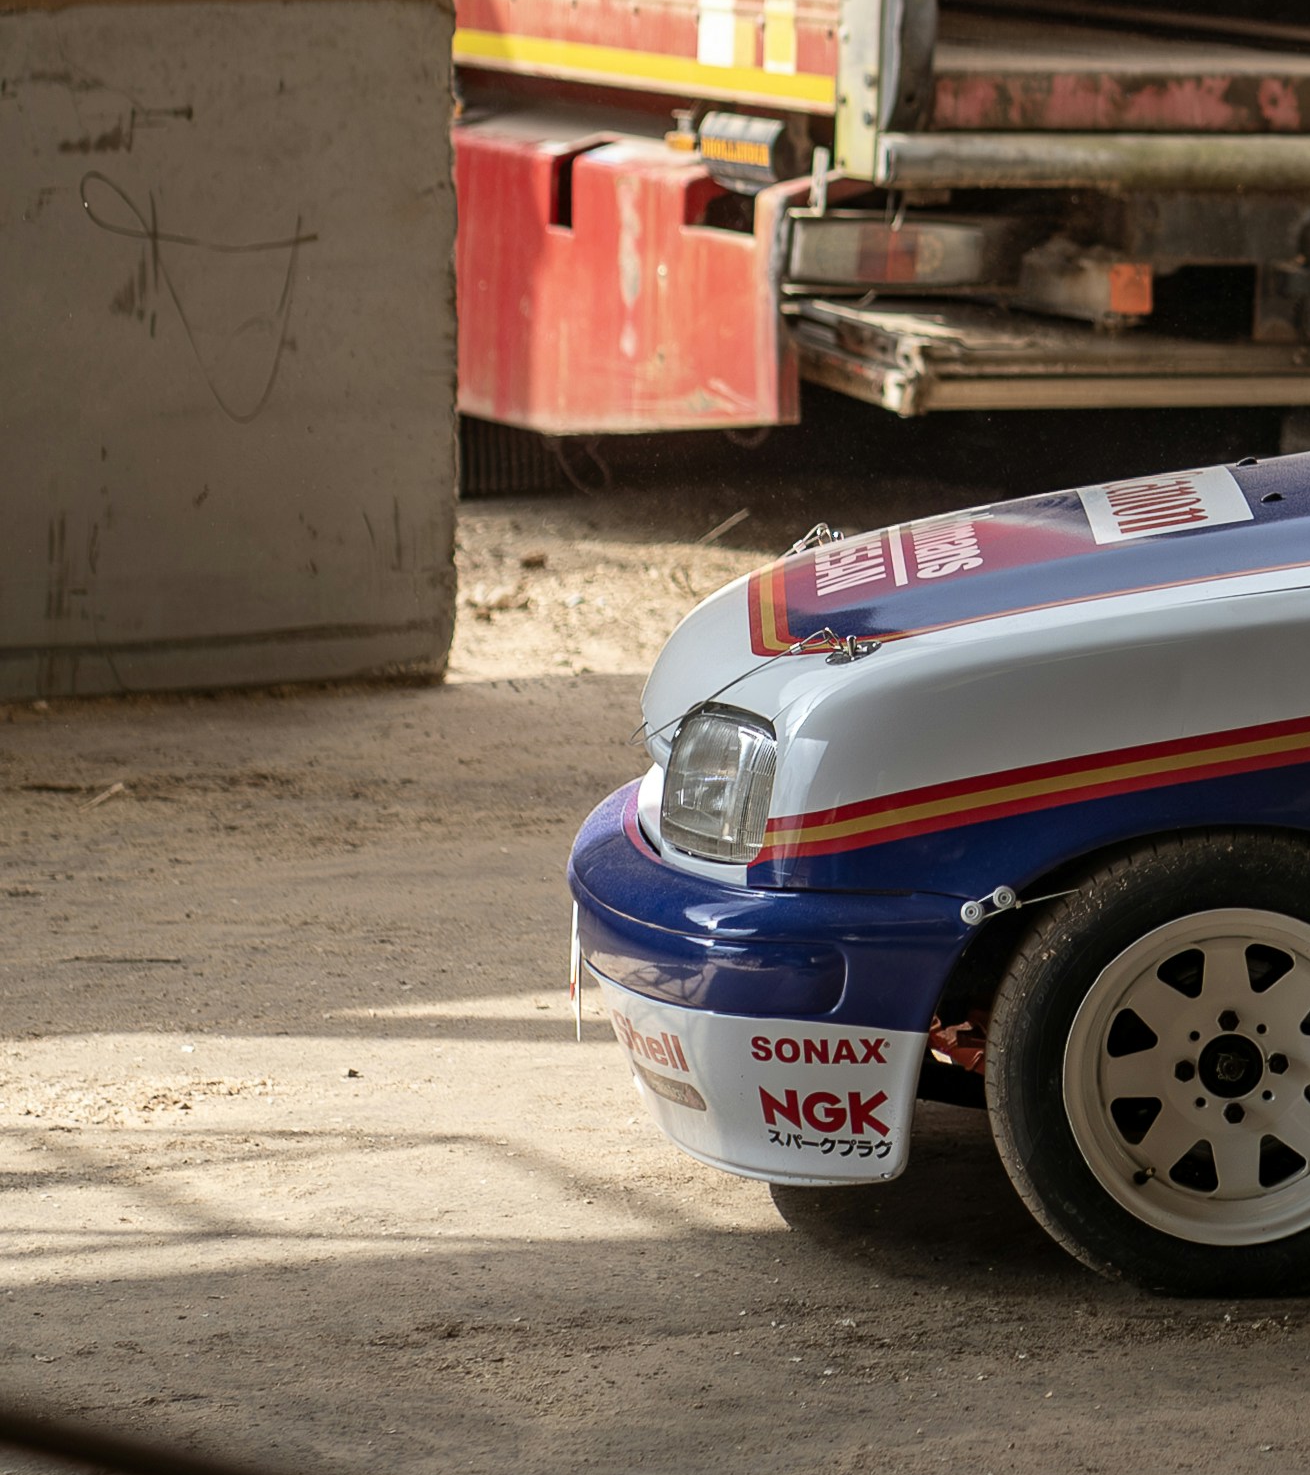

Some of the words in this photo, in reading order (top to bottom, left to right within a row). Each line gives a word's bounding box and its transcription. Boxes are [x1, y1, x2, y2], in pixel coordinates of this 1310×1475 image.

[612, 1009, 690, 1073] Shell
[750, 1035, 889, 1065] SONAX
[758, 1084, 891, 1138] NGK
[767, 1128, 893, 1160] スパークプラグ
